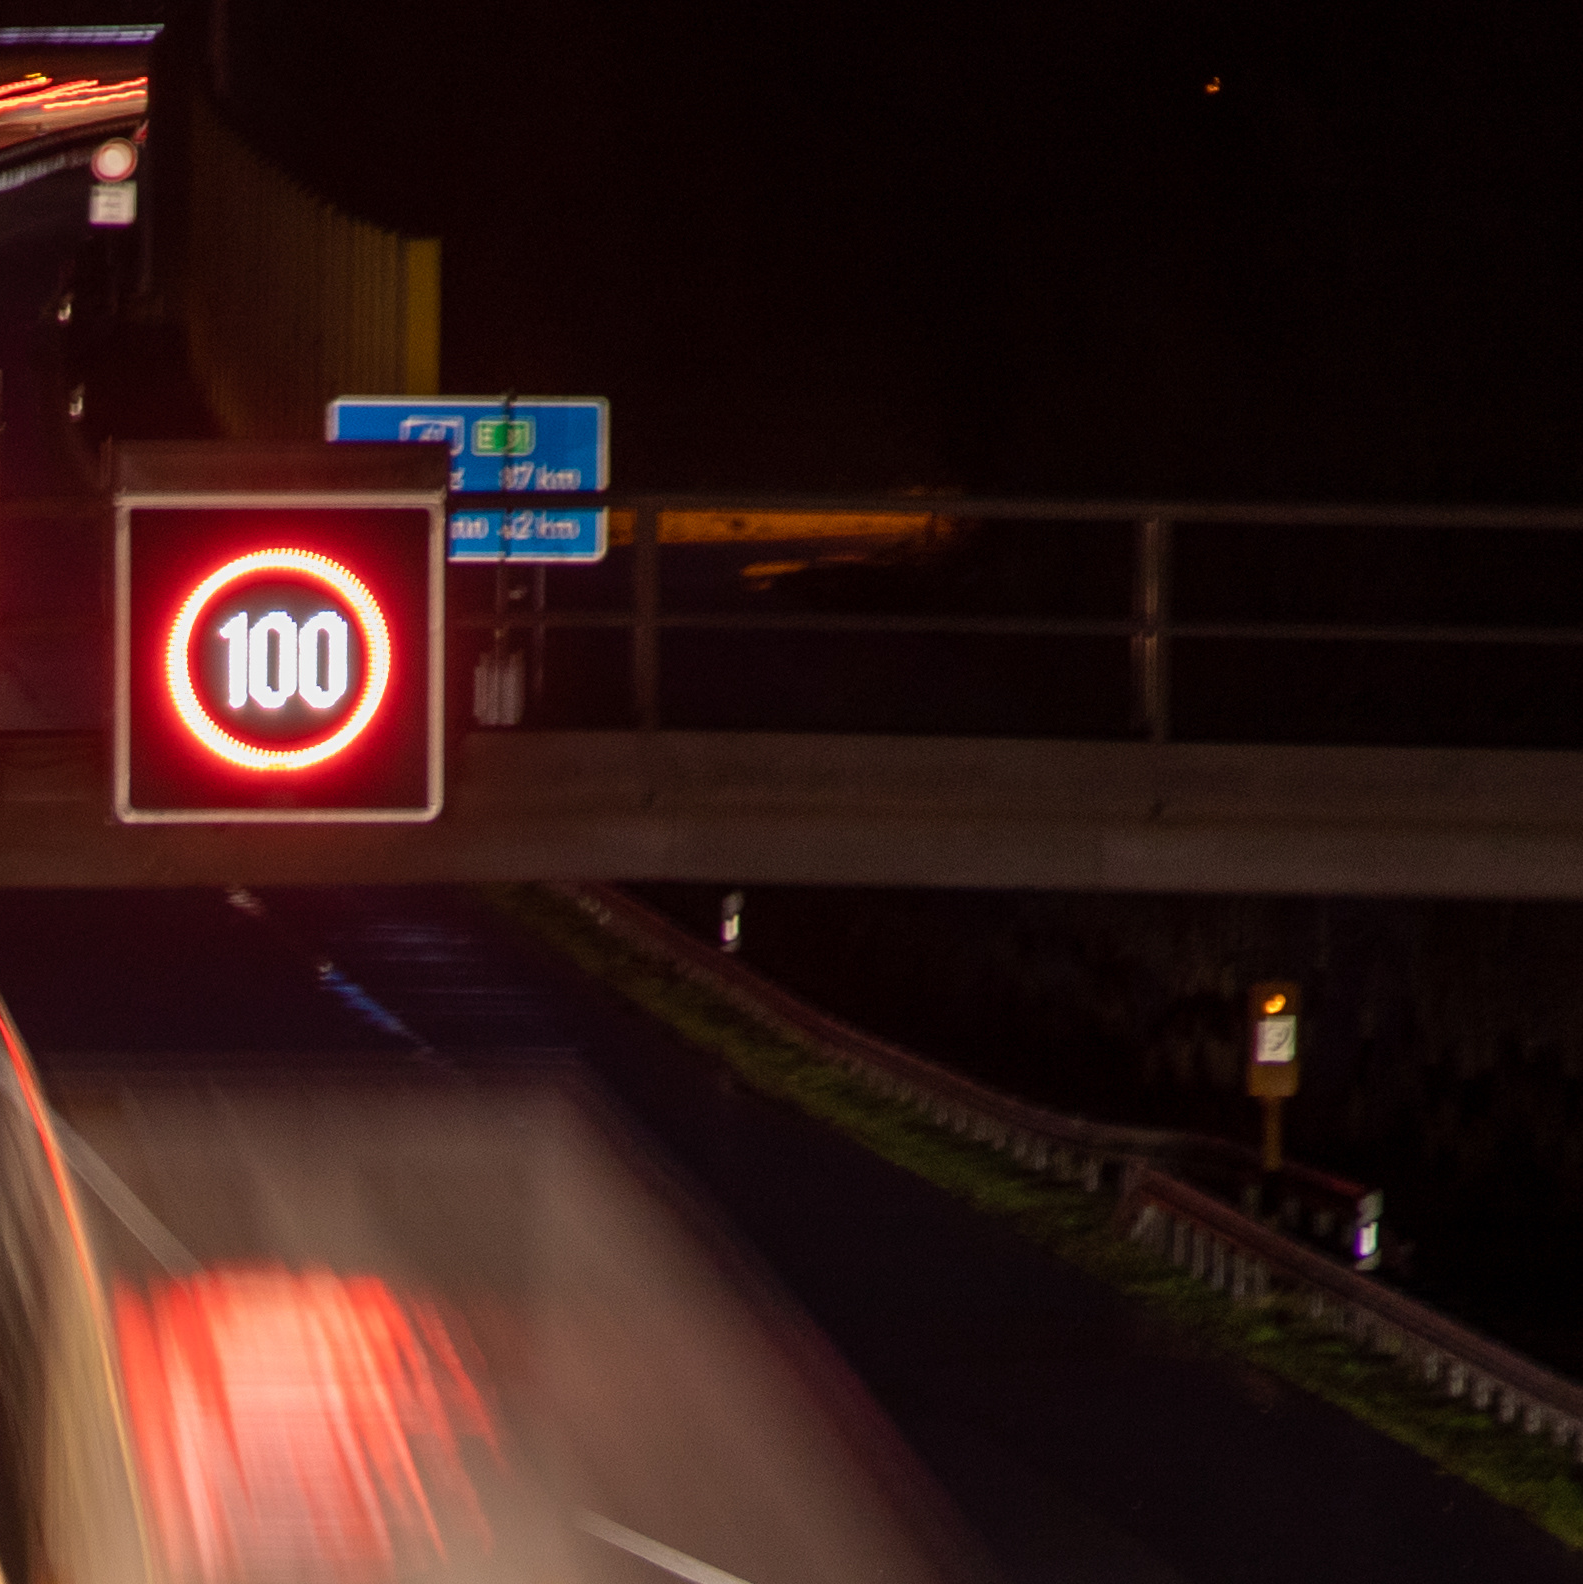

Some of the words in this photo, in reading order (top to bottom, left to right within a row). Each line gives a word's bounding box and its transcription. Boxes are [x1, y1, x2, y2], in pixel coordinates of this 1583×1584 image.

[536, 463, 581, 490] km
[535, 509, 580, 540] km
[218, 610, 348, 709] 100
